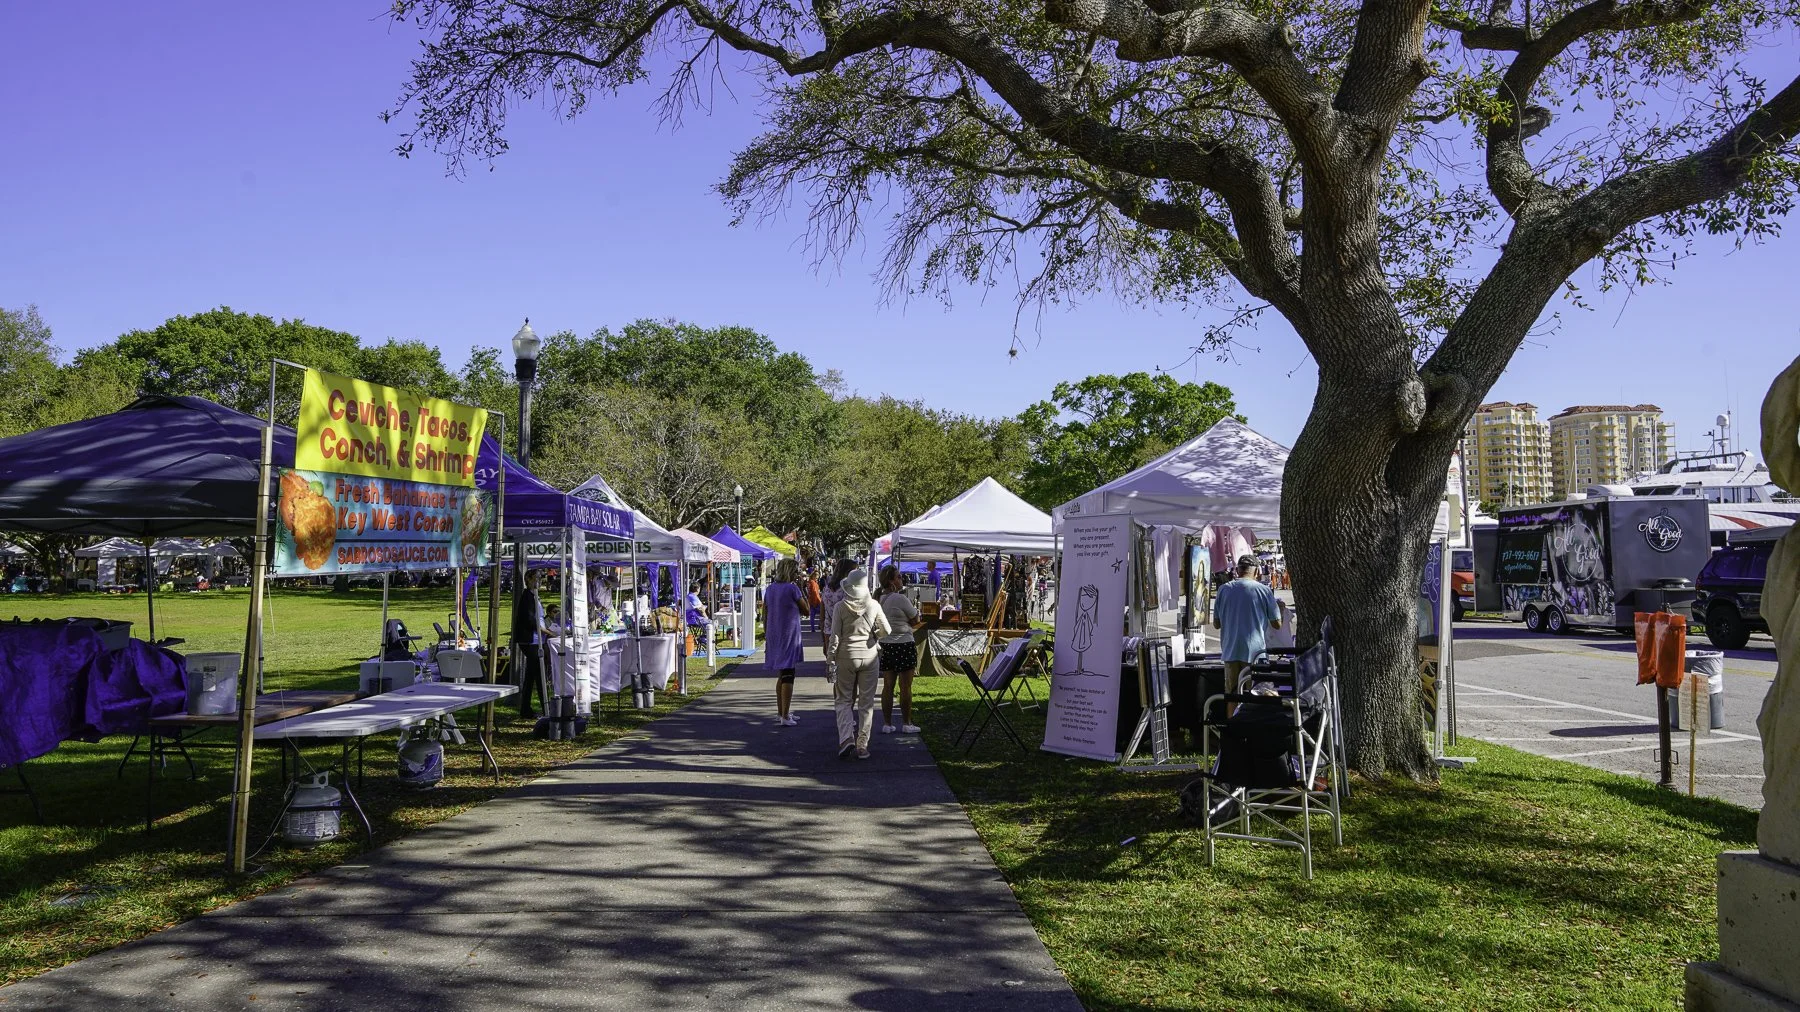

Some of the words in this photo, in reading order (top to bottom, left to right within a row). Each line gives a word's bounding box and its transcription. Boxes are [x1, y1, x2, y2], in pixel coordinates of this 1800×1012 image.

[328, 389, 413, 437] Ceviche,
[418, 407, 472, 444] Tacos,
[320, 427, 391, 470] Conch,
[397, 440, 410, 468] &
[415, 442, 474, 479] Shrimp
[335, 479, 380, 505] Fresh
[383, 484, 445, 509] Bahamas
[448, 493, 457, 510] &
[337, 508, 367, 536] Key
[371, 509, 410, 532] West
[413, 511, 453, 533] Conch
[569, 504, 591, 524] TAMPA
[591, 507, 602, 526] BAY
[602, 510, 621, 530] SOLAR
[1638, 517, 1659, 534] All
[564, 540, 652, 556] NREDIENTS
[1553, 524, 1577, 552] All
[1658, 527, 1683, 546] Good
[337, 546, 449, 565] SABROSOSAUCE.COM
[1574, 543, 1602, 574] Good
